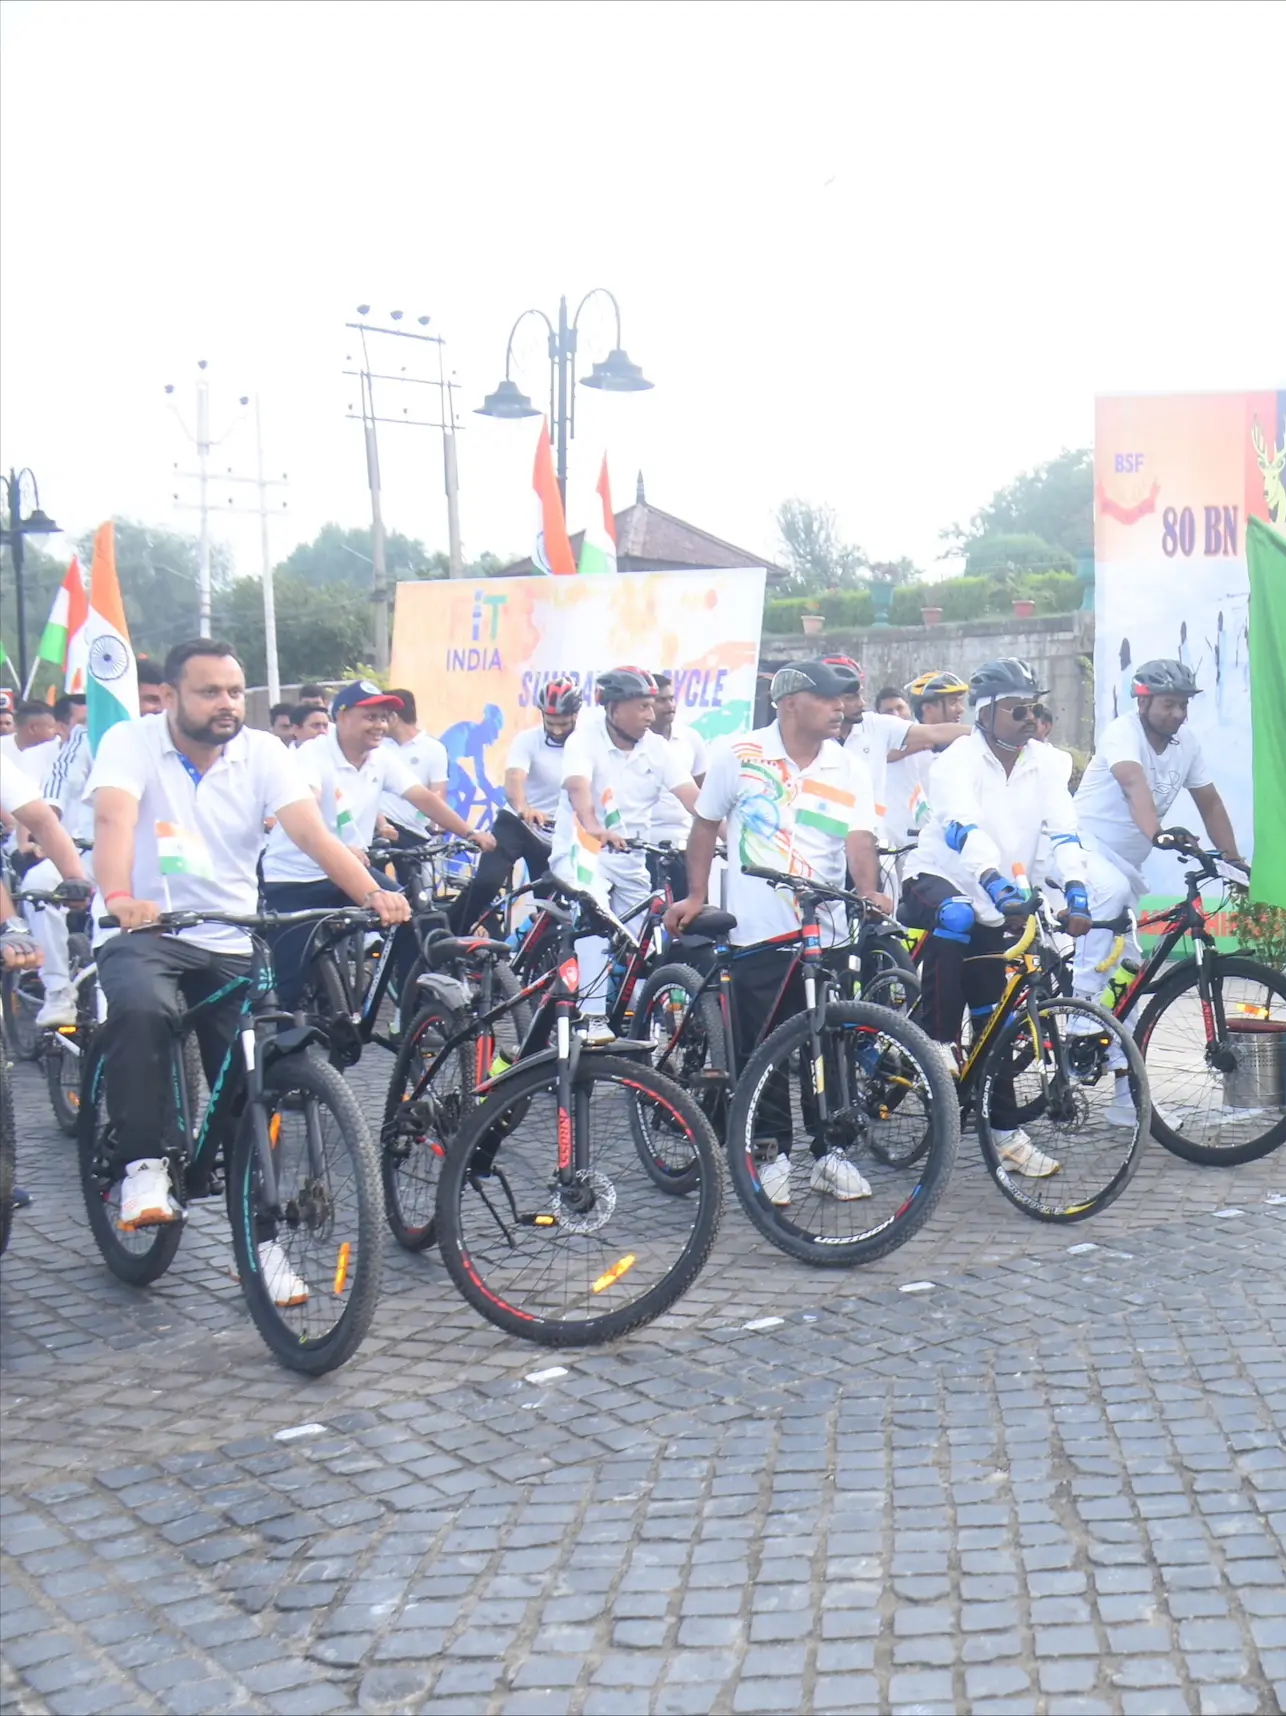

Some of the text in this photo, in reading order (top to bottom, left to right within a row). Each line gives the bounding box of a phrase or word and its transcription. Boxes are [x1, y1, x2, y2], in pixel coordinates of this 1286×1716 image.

[1114, 453, 1144, 473] BSF
[1161, 504, 1239, 558] 80 BN
[446, 647, 504, 673] INDIA
